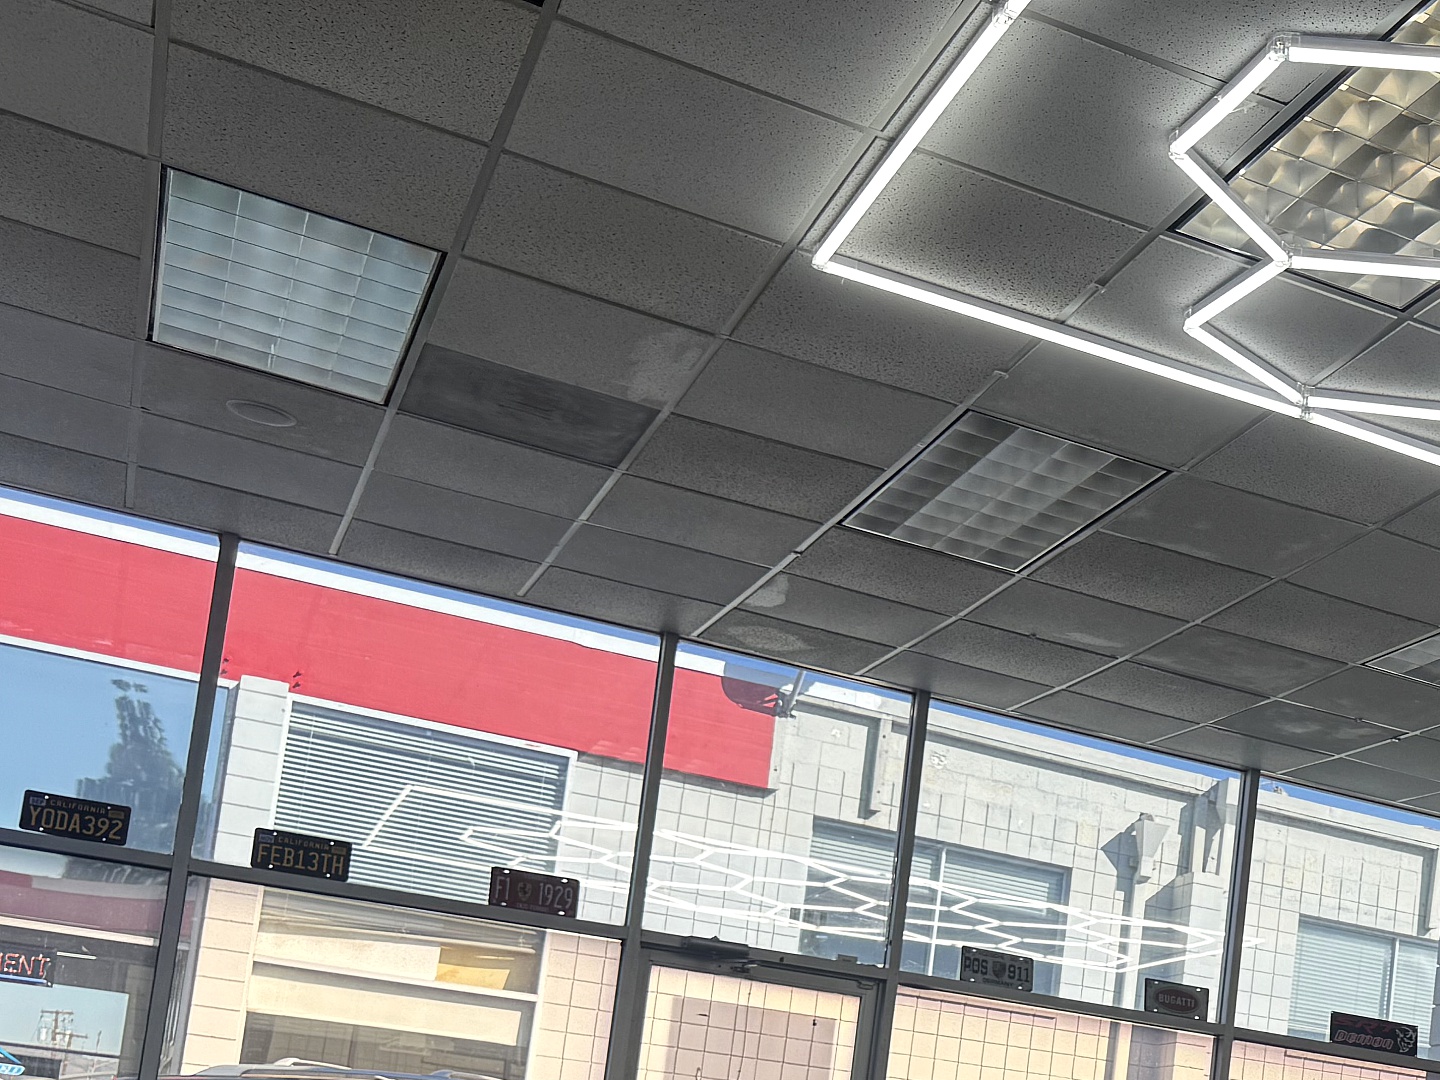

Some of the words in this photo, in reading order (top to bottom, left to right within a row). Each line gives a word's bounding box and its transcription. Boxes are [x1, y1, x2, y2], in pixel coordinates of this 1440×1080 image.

[50, 799, 106, 814] CALIFORNIA
[29, 805, 123, 840] YODA392
[278, 836, 330, 850] CALIFORNIA
[256, 843, 344, 875] FEB13TH
[495, 876, 511, 901] F1
[538, 882, 573, 909] 1929
[0, 952, 50, 977] ENT
[1007, 964, 1030, 983] 911
[1158, 993, 1195, 1008] BUGATTI
